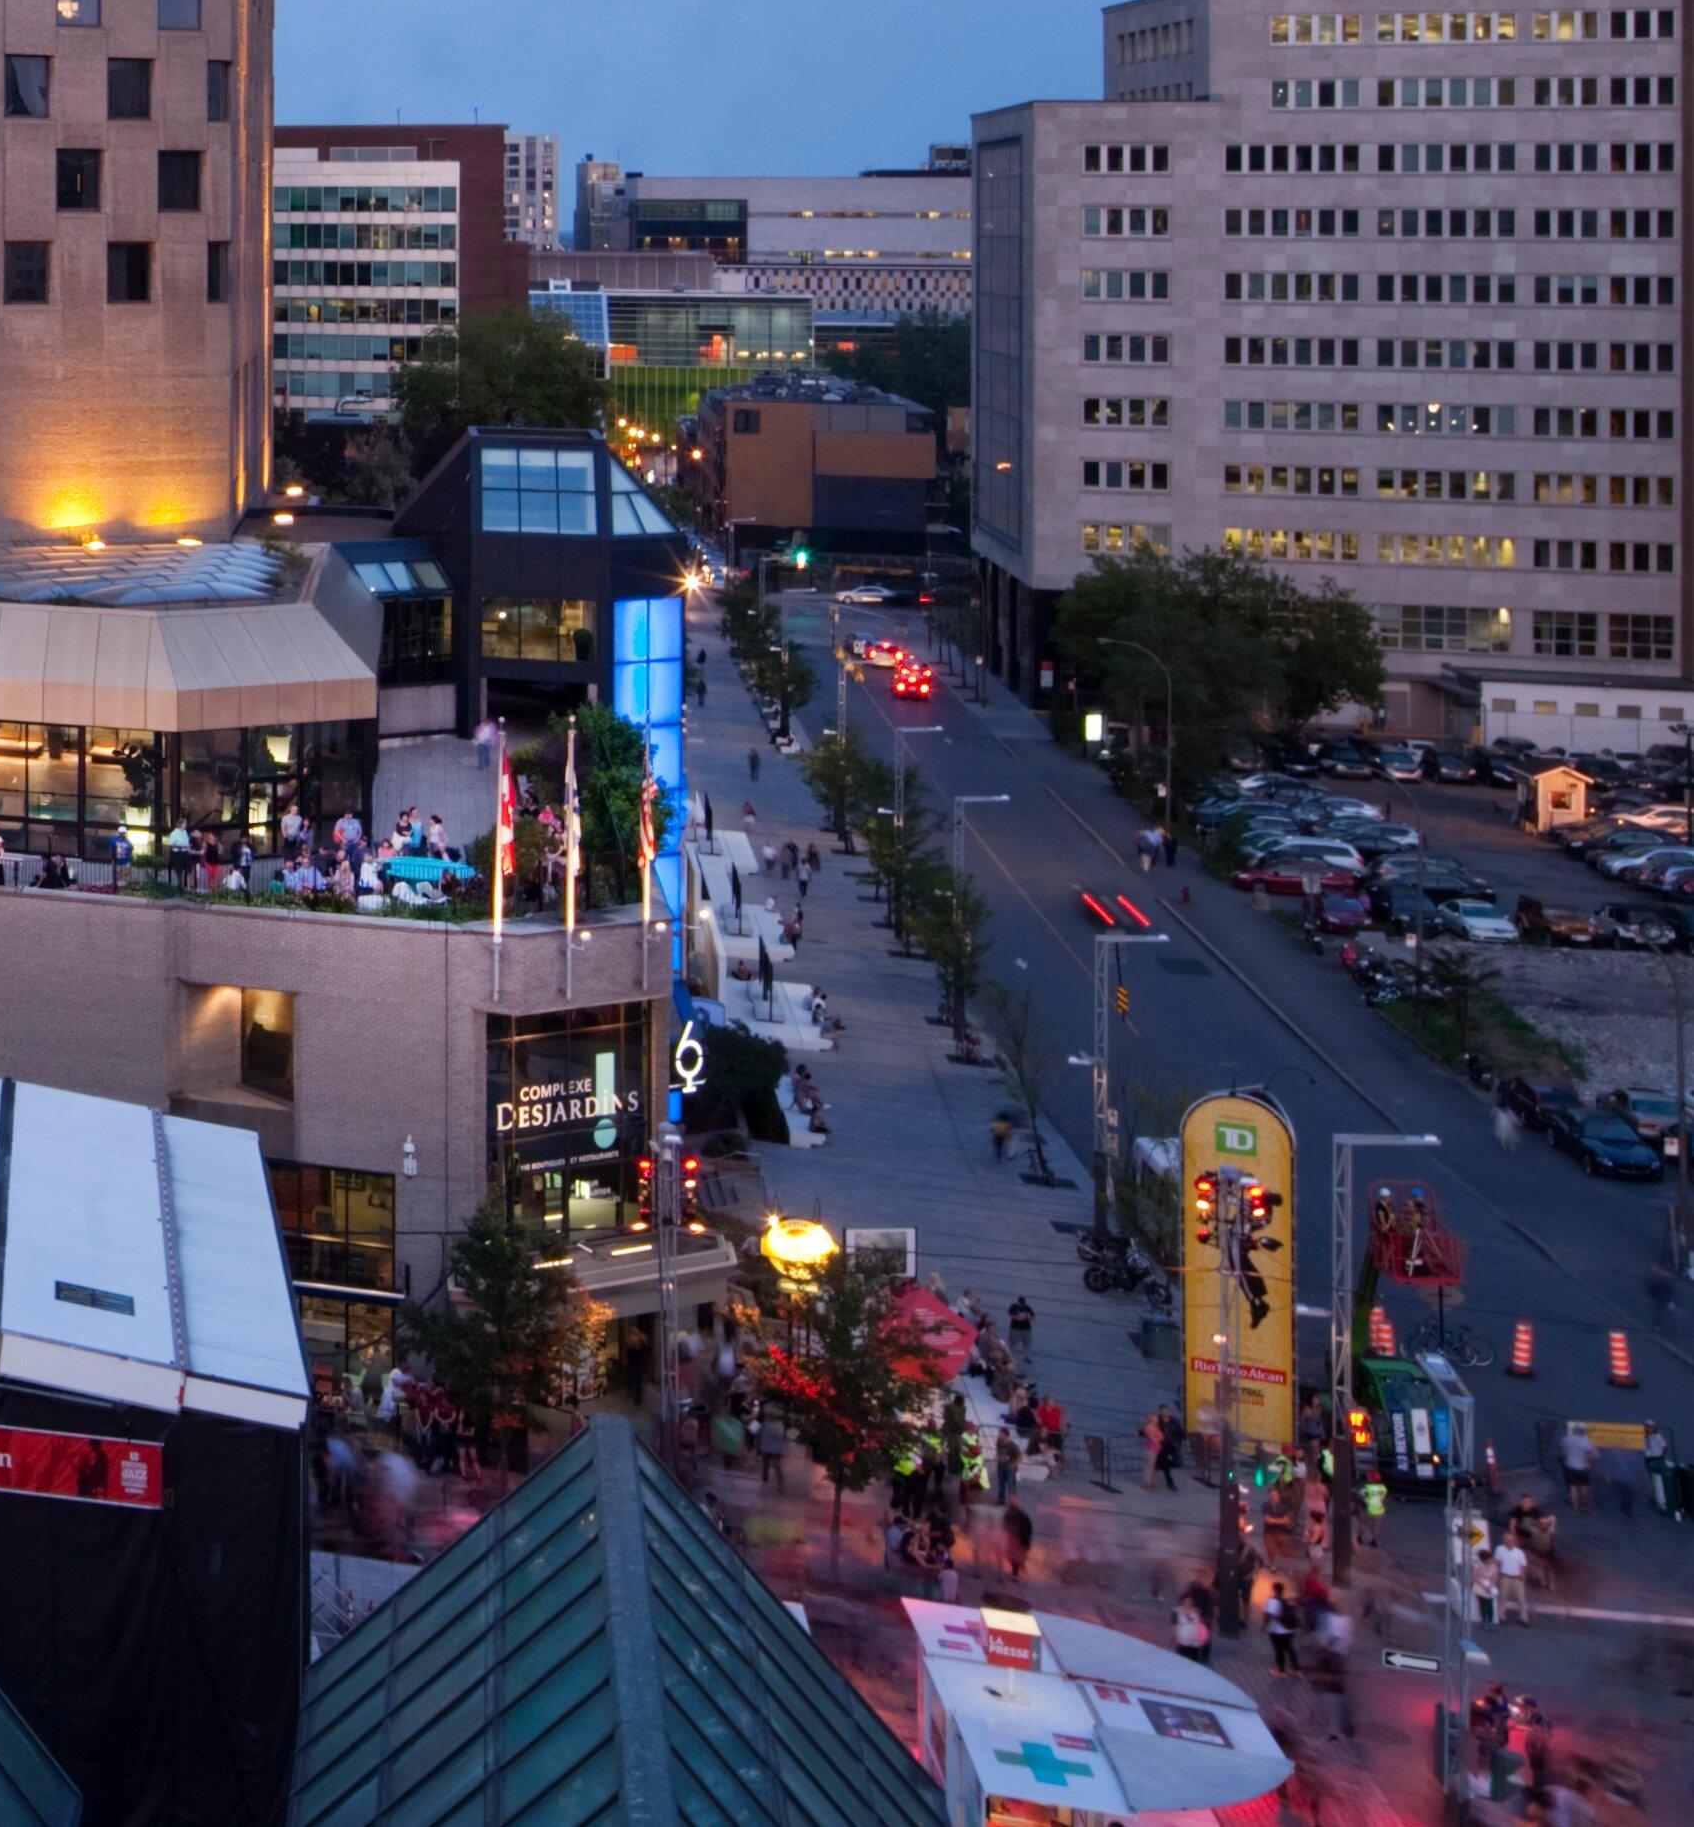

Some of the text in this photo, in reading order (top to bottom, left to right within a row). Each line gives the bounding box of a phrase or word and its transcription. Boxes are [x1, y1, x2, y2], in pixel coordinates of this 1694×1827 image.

[520, 1078, 592, 1102] COMPLEXE
[1217, 1126, 1255, 1151] TD
[989, 1636, 1004, 1646] LA
